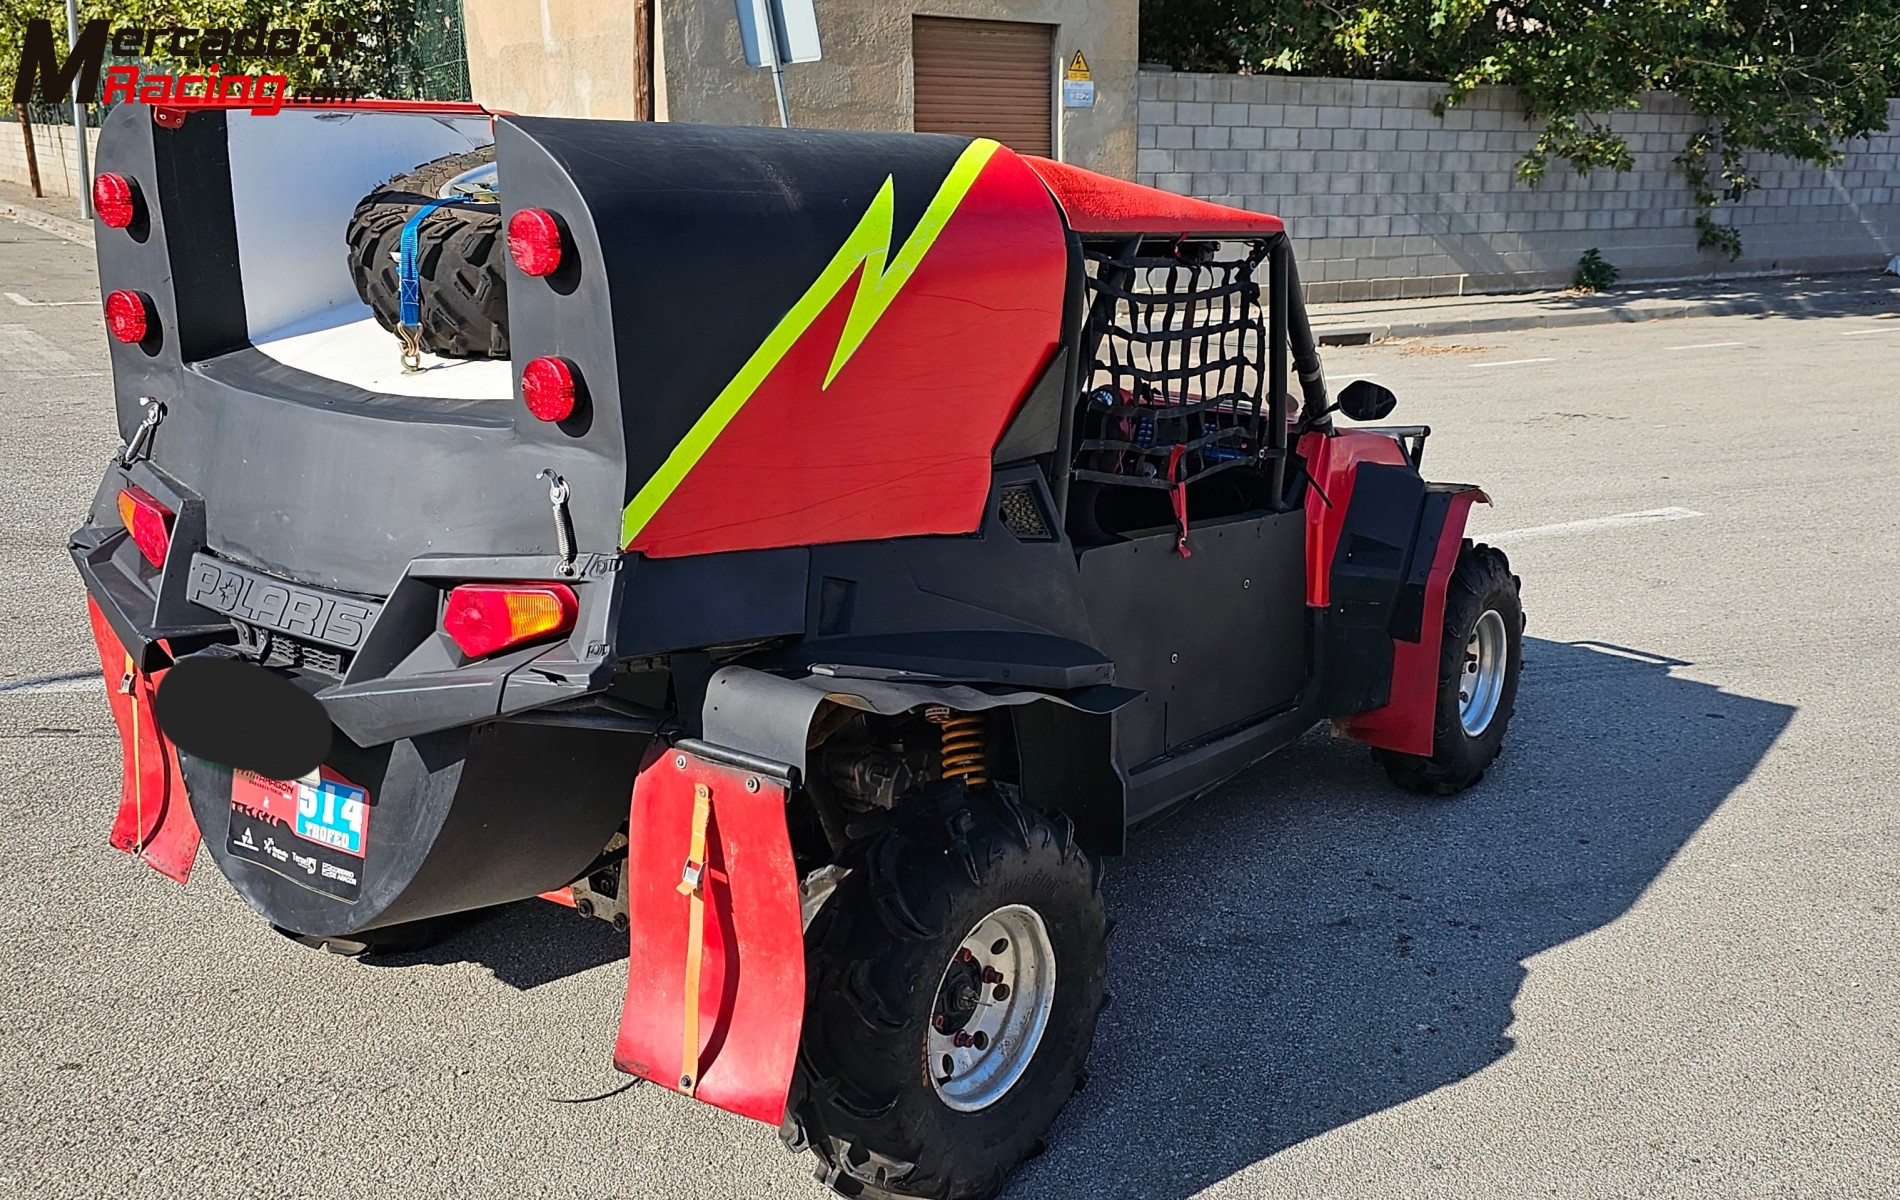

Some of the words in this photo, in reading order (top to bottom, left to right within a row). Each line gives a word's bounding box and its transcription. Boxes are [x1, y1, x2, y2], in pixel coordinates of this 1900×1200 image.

[194, 562, 370, 648] POLARIS
[299, 783, 363, 834] 514
[304, 820, 350, 849] TROFEO
